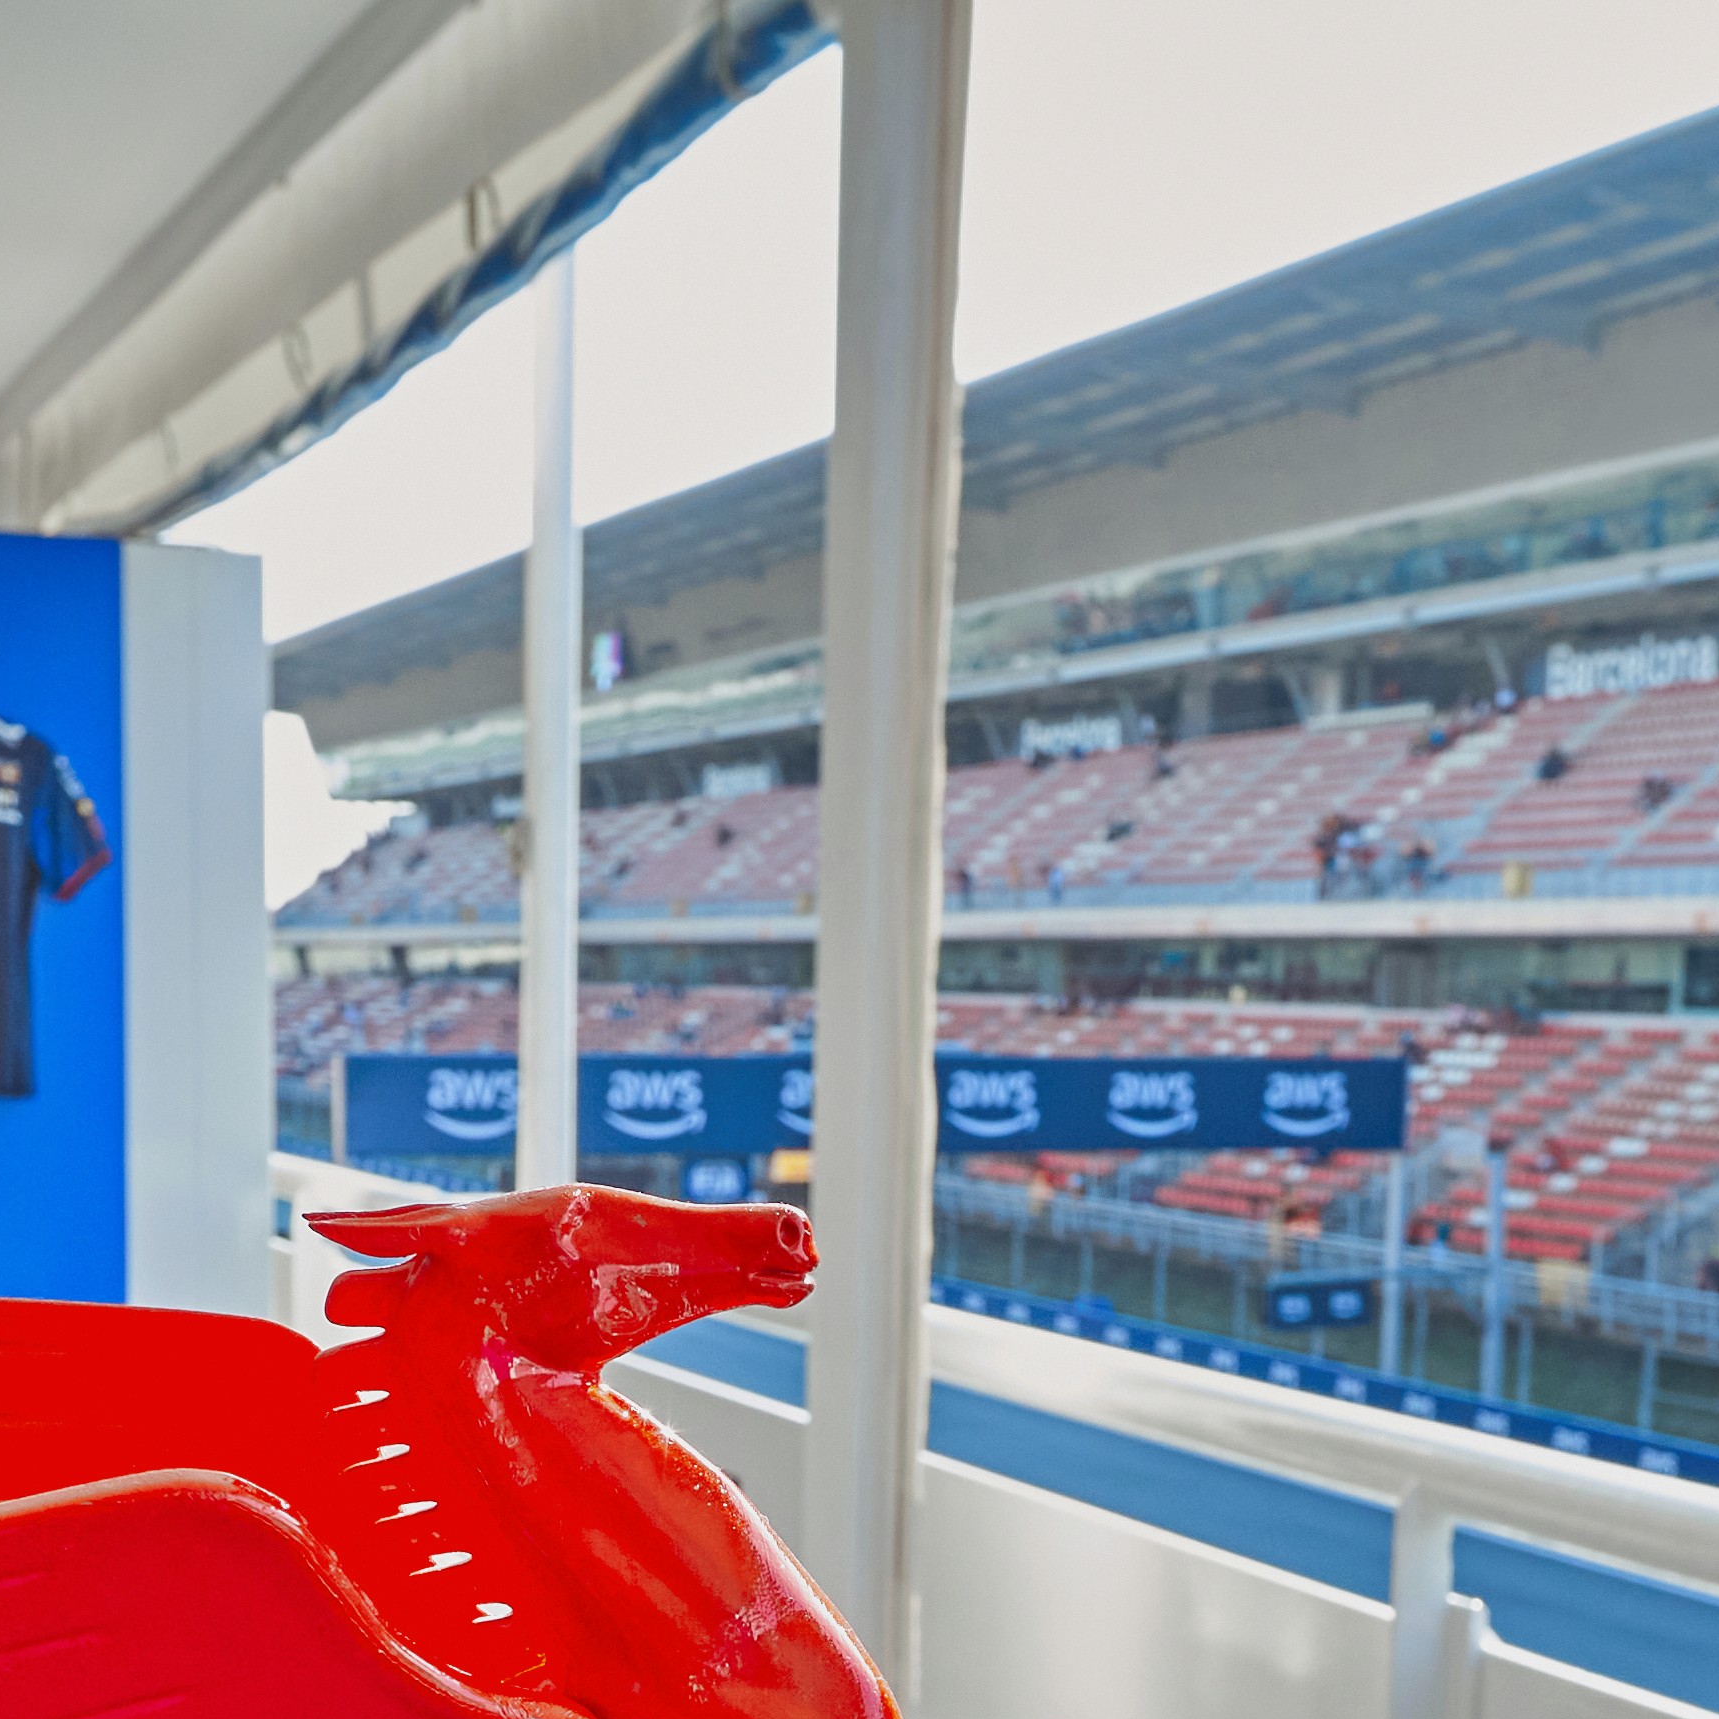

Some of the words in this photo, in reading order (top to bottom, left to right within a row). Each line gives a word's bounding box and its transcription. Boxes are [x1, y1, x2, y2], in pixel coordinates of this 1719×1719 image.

[607, 1069, 703, 1112] aws
[947, 1070, 1037, 1109] aws
[1108, 1071, 1196, 1109] aws
[1264, 1071, 1348, 1111] aws
